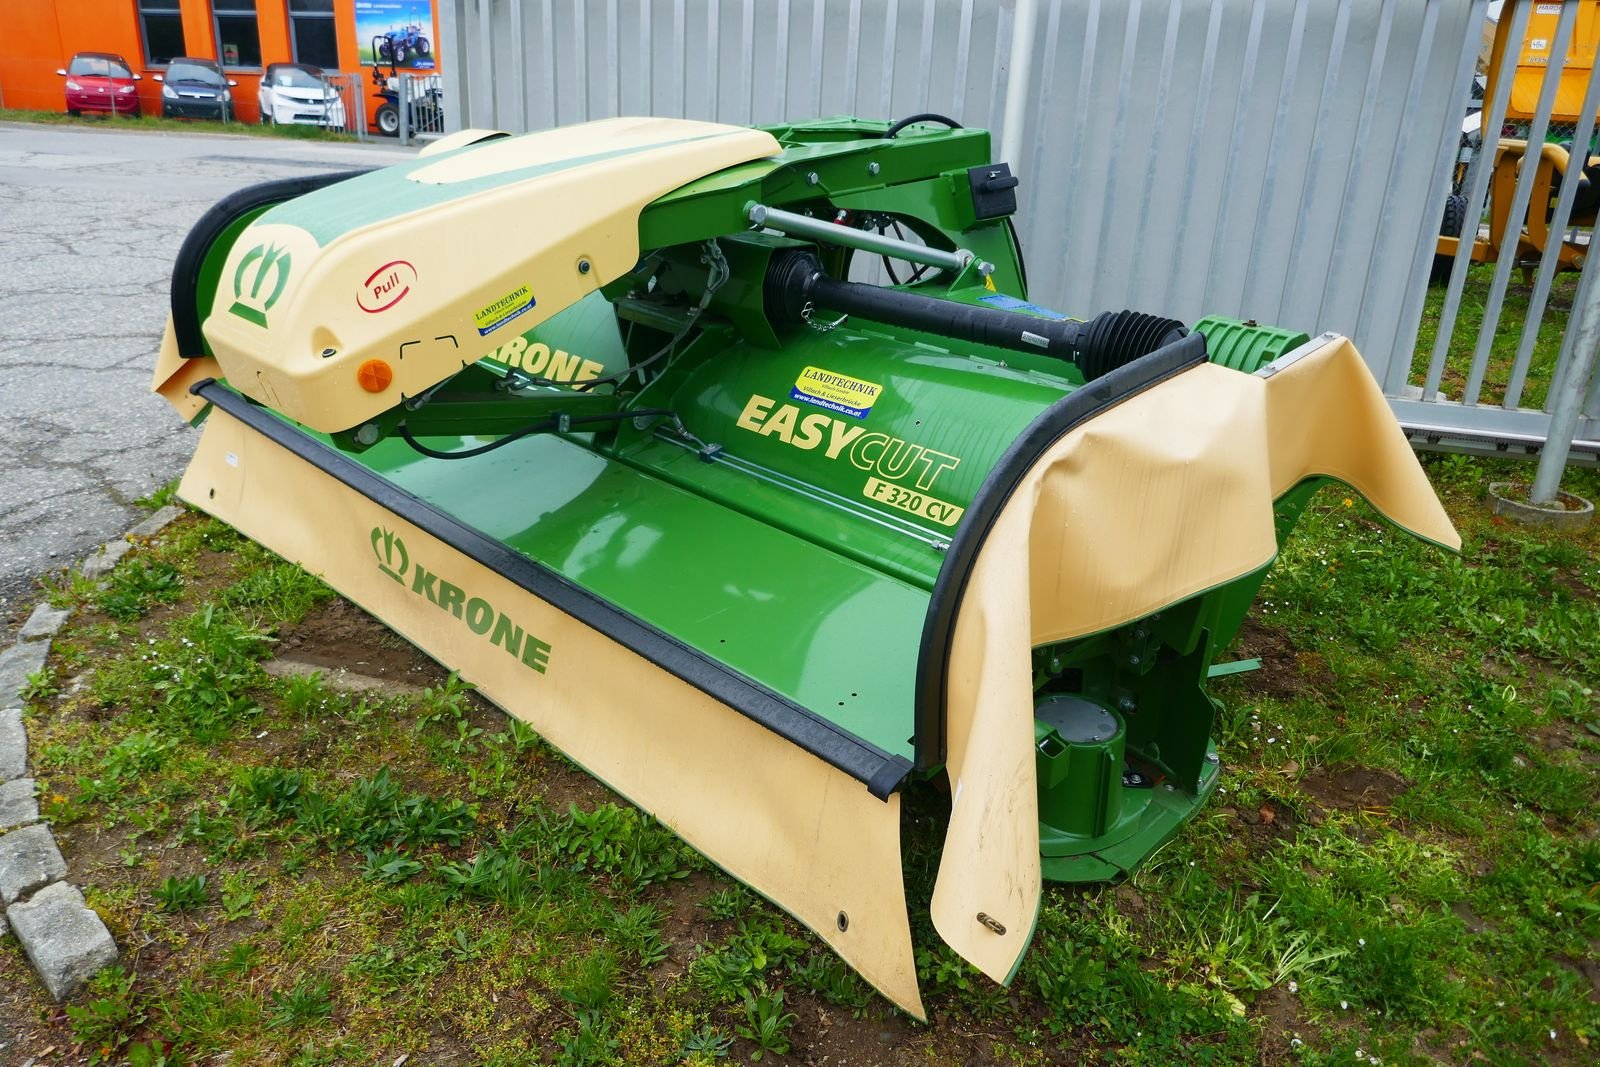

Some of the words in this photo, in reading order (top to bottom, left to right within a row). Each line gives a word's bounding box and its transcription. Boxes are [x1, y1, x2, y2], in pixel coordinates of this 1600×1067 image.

[373, 272, 400, 300] Pull
[475, 286, 529, 321] LANDTECHNIK
[803, 369, 878, 397] LANDTECHNIK
[803, 386, 821, 395] Villach
[793, 393, 862, 417] www.landtechnik.co.at
[871, 482, 887, 498] F
[886, 487, 923, 512] 320
[925, 501, 955, 523] CV
[411, 562, 552, 675] KRONE
